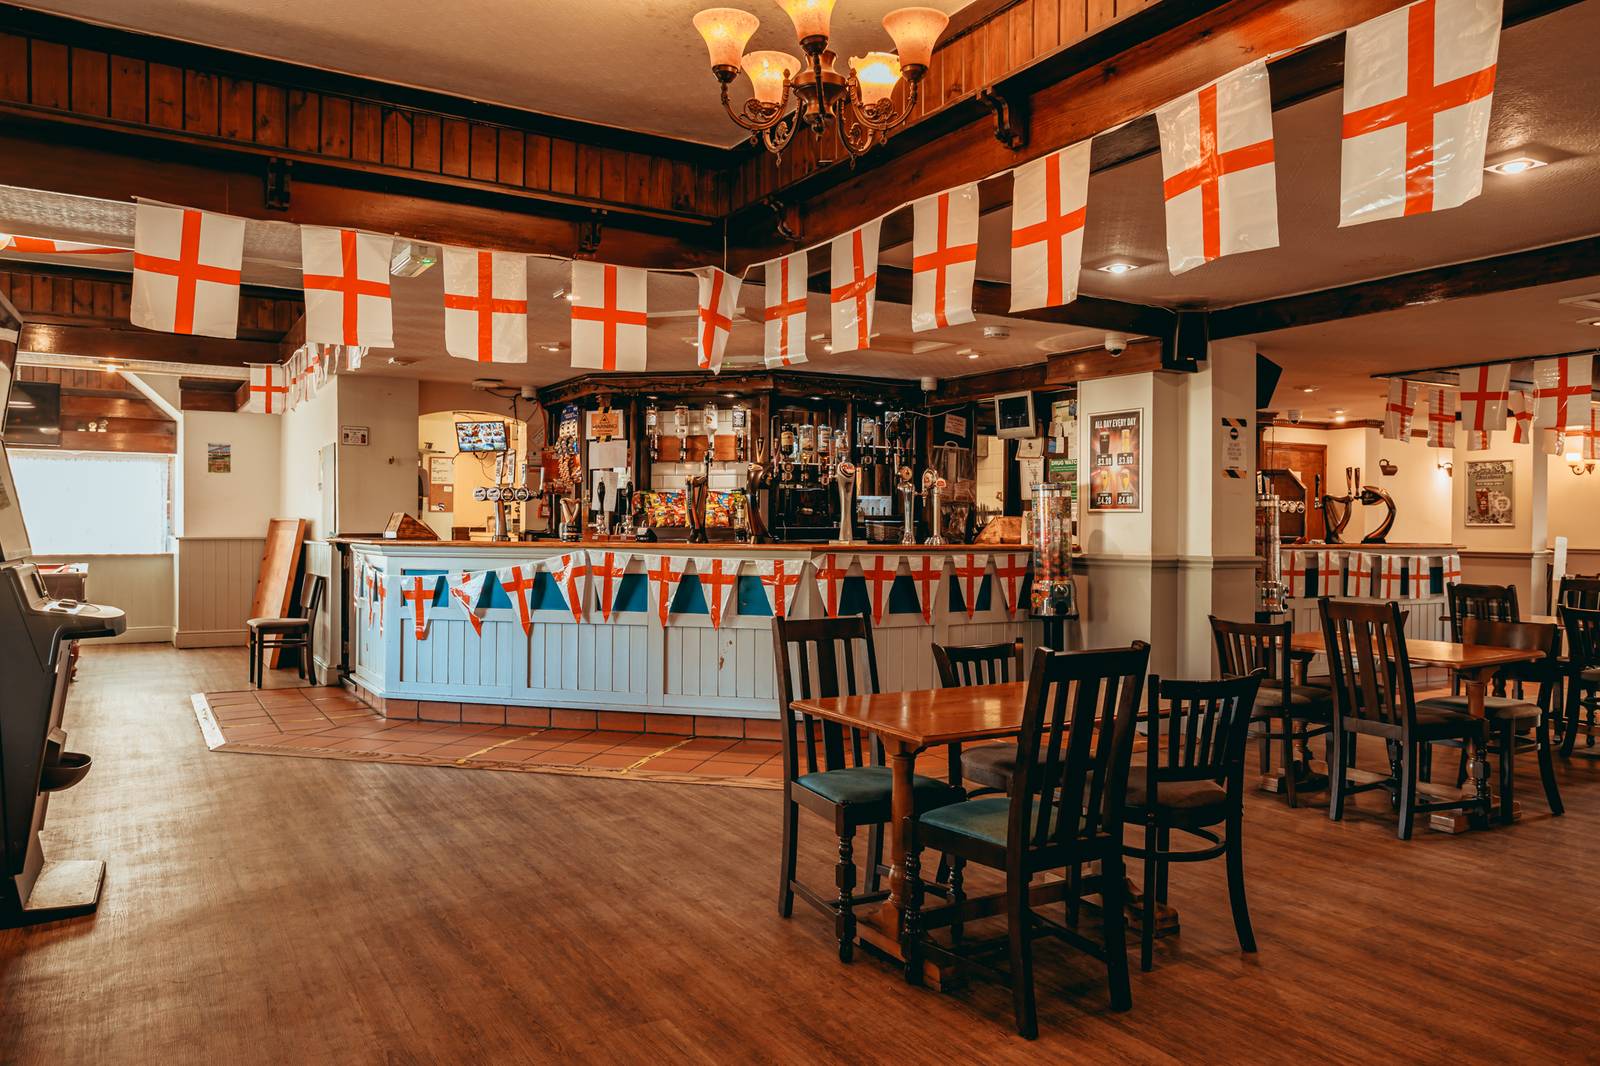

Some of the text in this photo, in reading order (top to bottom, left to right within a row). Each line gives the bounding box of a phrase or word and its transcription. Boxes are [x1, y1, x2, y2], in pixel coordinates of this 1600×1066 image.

[1095, 417, 1136, 429] ALL DAY EVERY DAY
